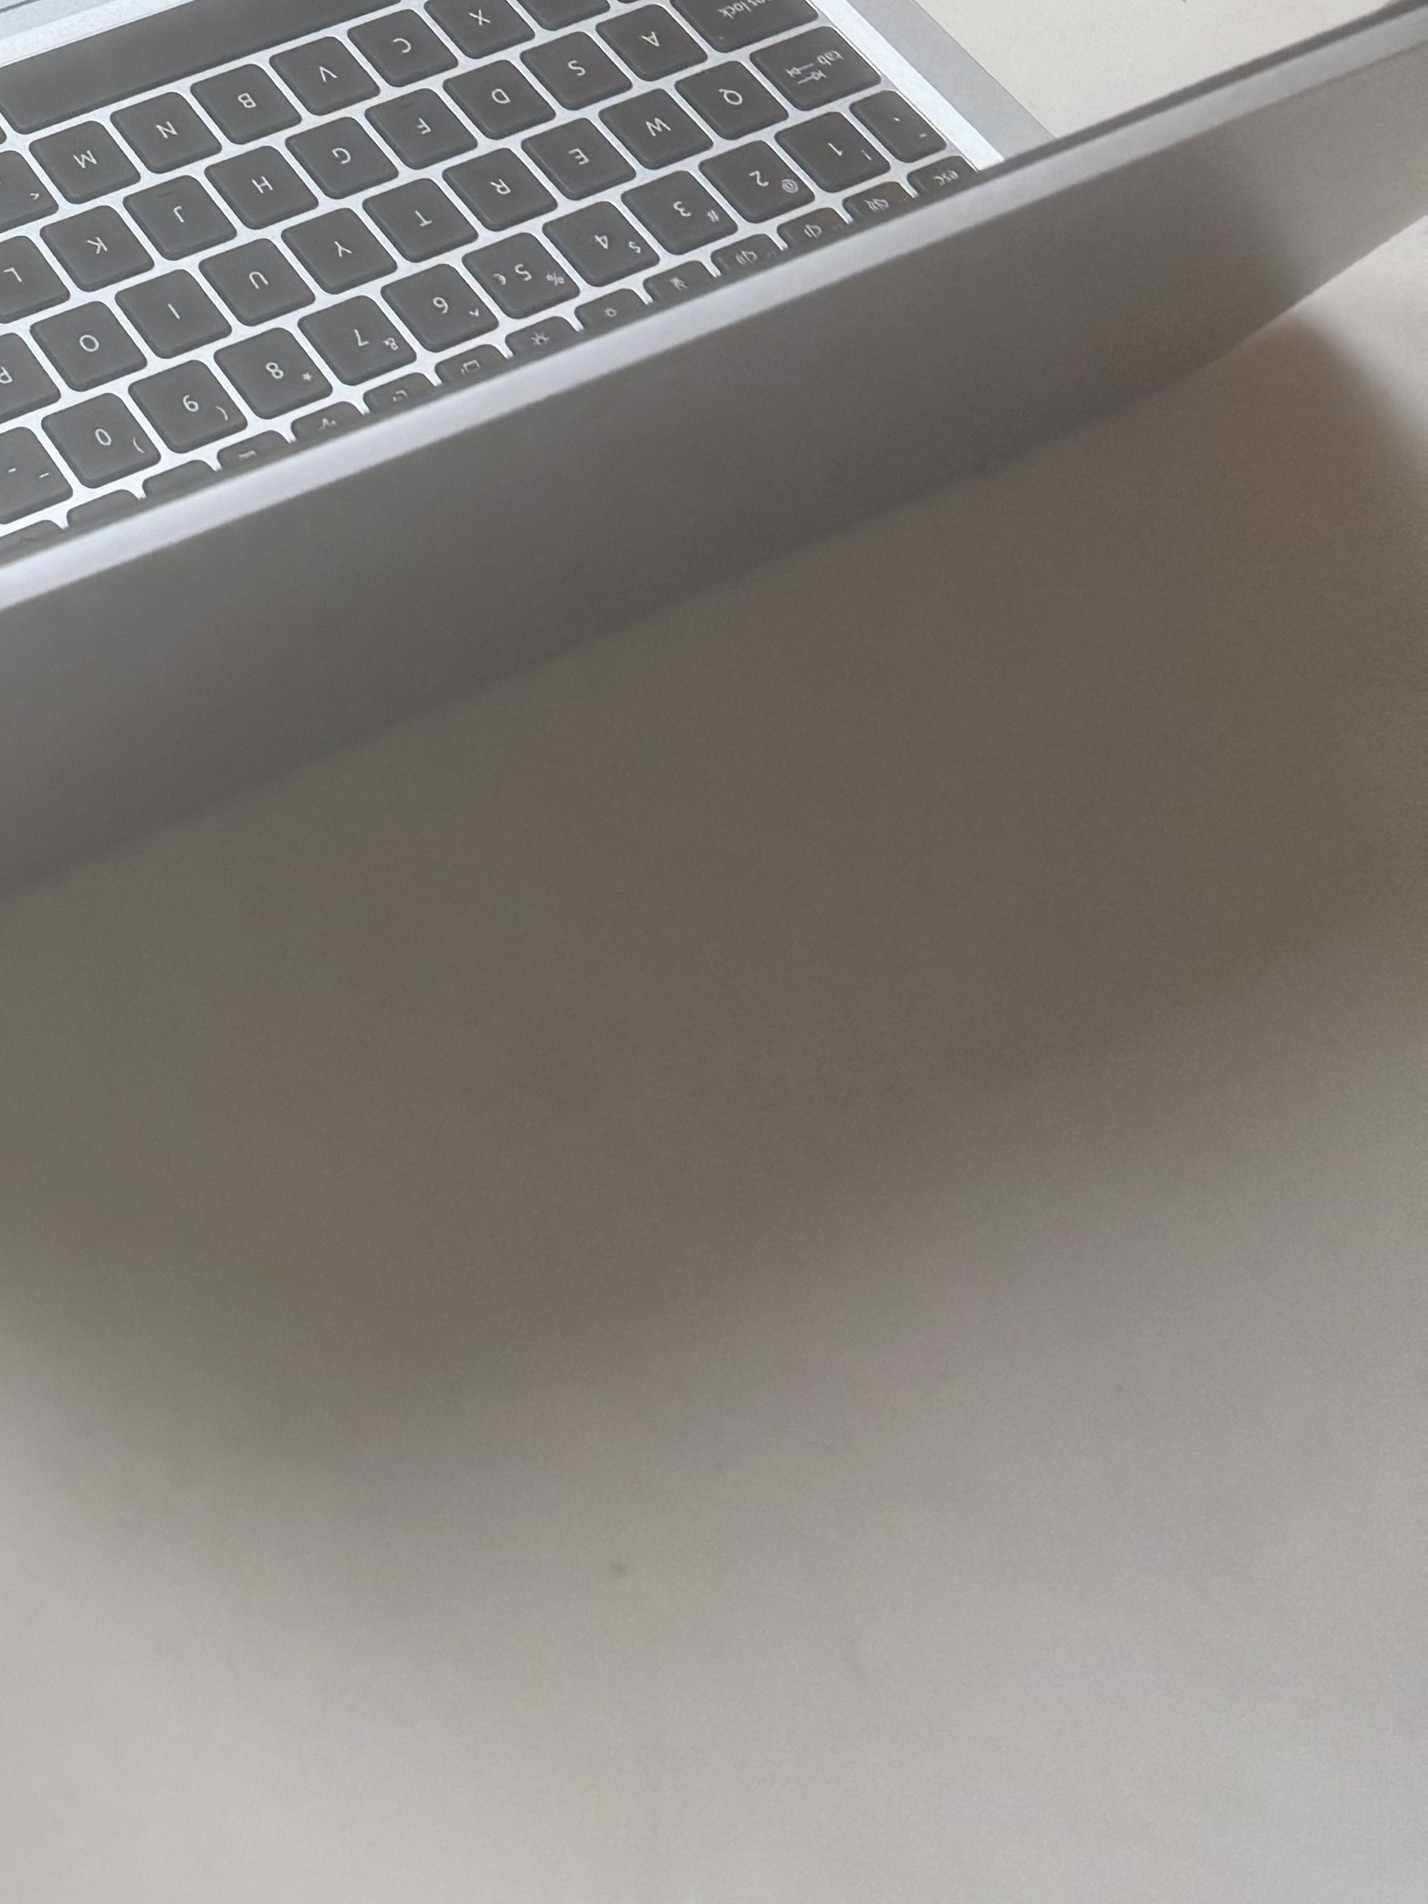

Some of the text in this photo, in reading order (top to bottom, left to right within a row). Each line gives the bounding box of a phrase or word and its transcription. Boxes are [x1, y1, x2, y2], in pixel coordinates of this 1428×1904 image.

[468, 9, 491, 26] X
[718, 0, 749, 19] lock
[392, 37, 412, 54] C
[641, 31, 660, 47] A
[817, 49, 843, 66] tab
[319, 66, 338, 82] V
[567, 59, 586, 77] S
[237, 92, 257, 109] B
[491, 88, 511, 104] D
[718, 88, 743, 106] Q
[155, 121, 178, 139] N
[417, 118, 432, 135] F
[645, 117, 672, 137] W
[331, 147, 351, 165] G
[568, 148, 590, 165] E
[827, 142, 843, 157] 1
[73, 149, 97, 169] M
[251, 175, 273, 194] H
[490, 178, 511, 195] R
[748, 170, 769, 187] 2
[932, 170, 959, 187] esc
[173, 205, 185, 223] J
[673, 200, 692, 217] 3
[414, 210, 433, 227] T
[87, 236, 108, 255] K
[334, 240, 353, 258] Y
[594, 234, 609, 250] 4
[3, 267, 23, 283] L
[248, 271, 269, 289] U
[514, 263, 533, 282] 5
[167, 303, 180, 320] I
[432, 296, 449, 314] 6
[79, 334, 100, 353] O
[354, 328, 369, 347] 7
[265, 361, 284, 380] 8
[182, 394, 199, 413] 9
[94, 428, 112, 446] 0
